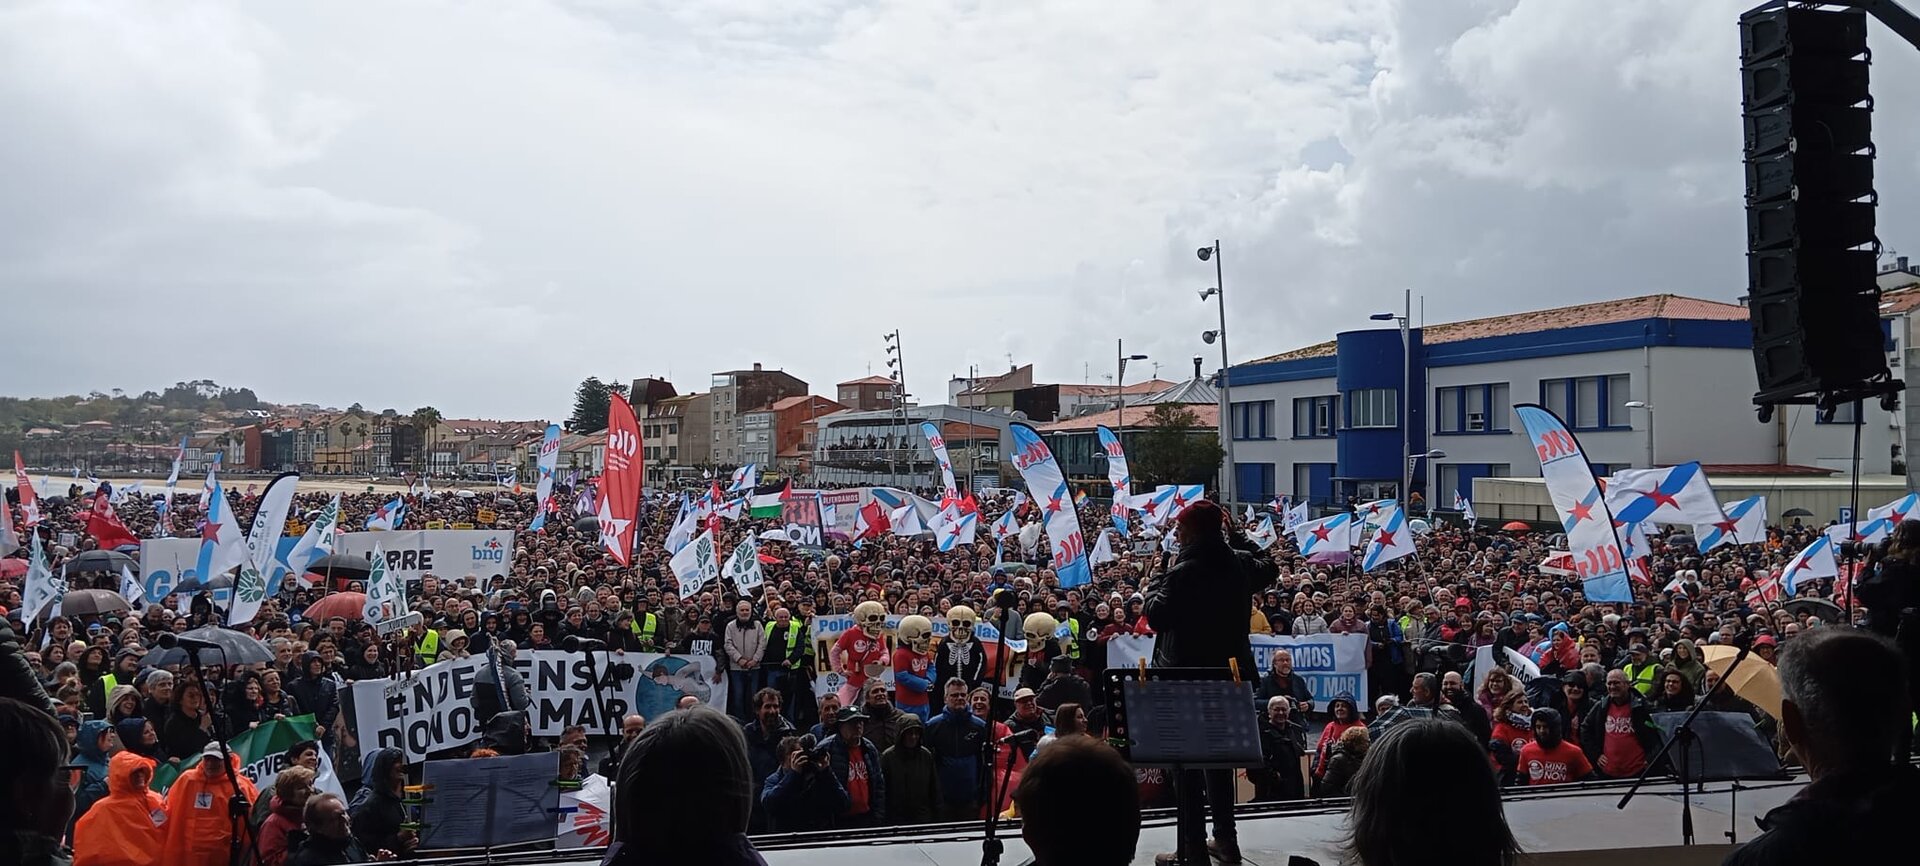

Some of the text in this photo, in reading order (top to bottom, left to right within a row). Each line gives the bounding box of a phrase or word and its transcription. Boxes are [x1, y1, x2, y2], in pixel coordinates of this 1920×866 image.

[1842, 509, 1852, 523] P
[472, 546, 503, 563] bng
[1544, 762, 1567, 771] MINA
[1544, 771, 1567, 781] NON
